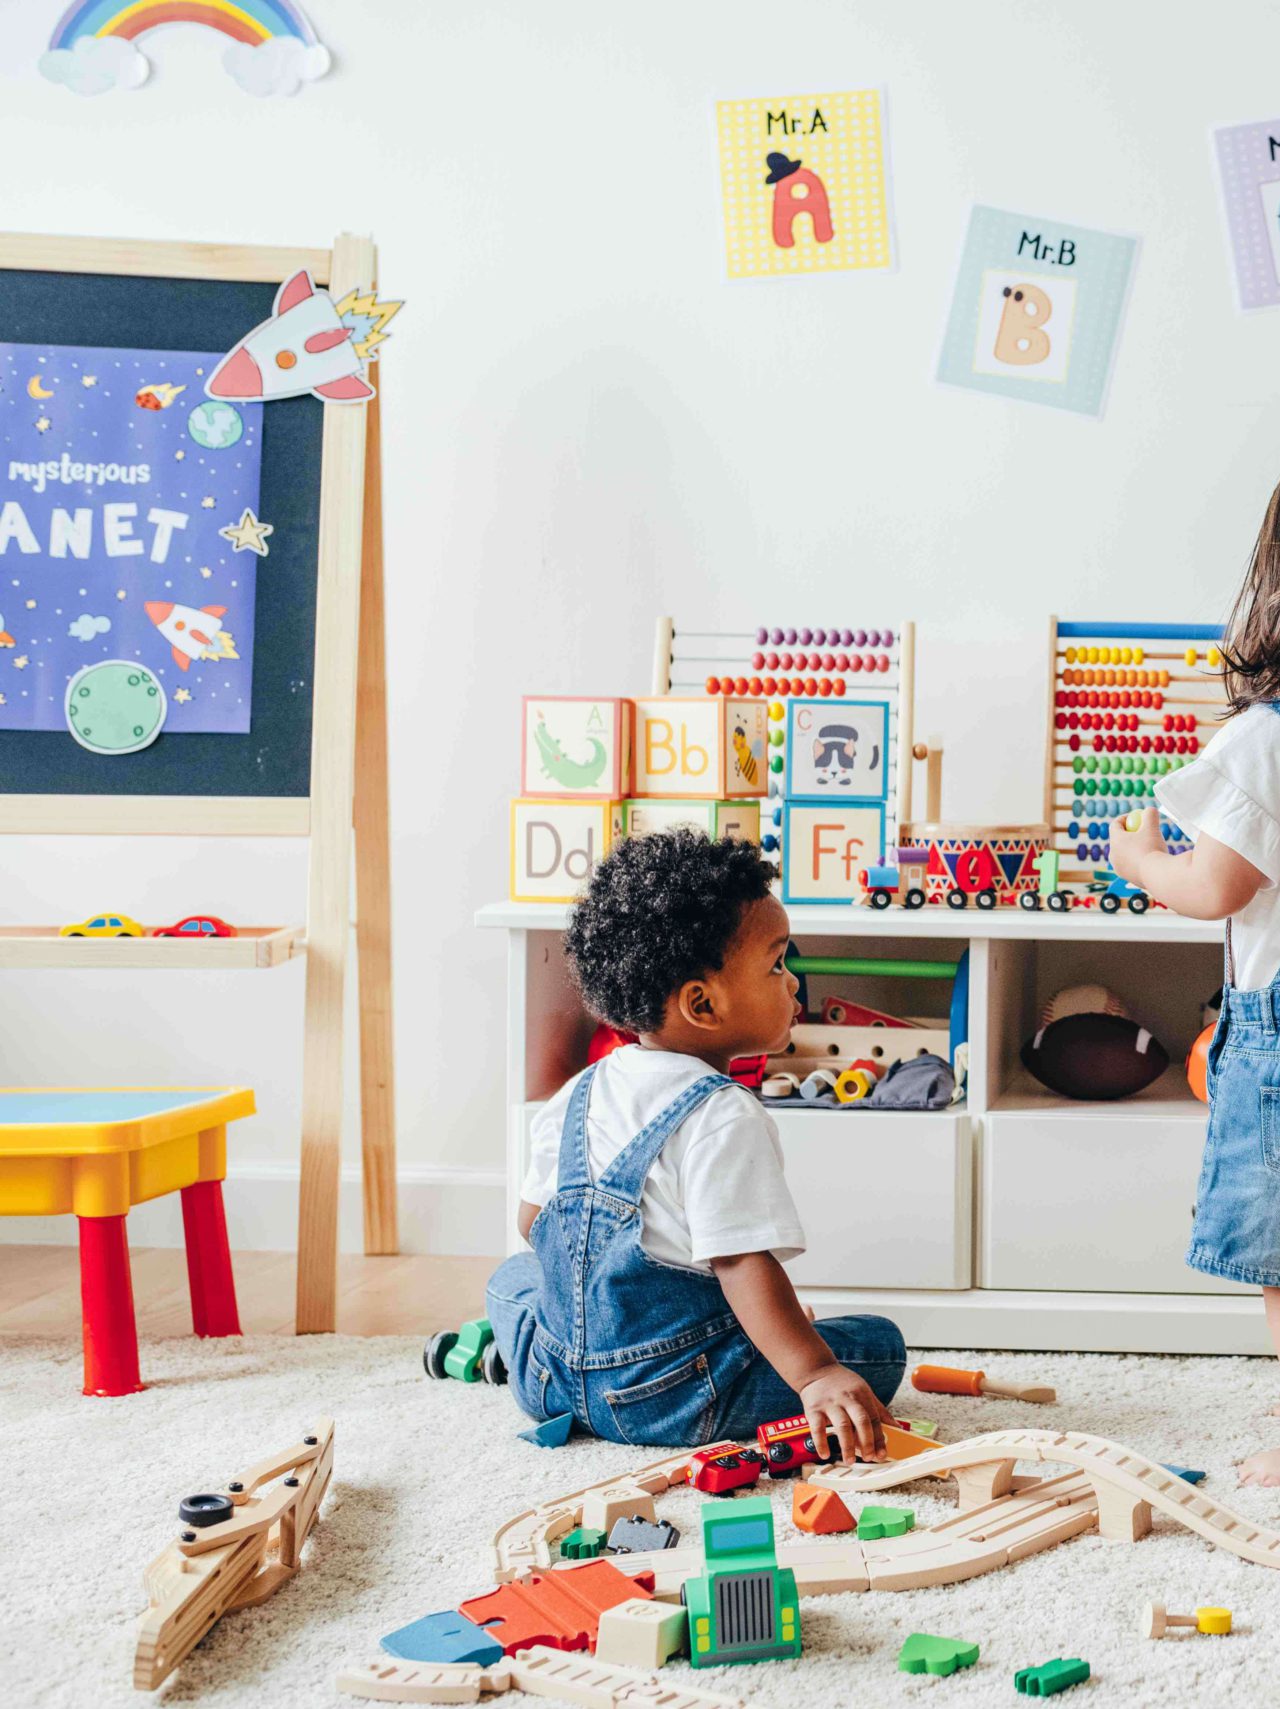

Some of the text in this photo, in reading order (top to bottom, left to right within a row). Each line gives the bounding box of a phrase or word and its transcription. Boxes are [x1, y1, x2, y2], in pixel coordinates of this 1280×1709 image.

[766, 108, 829, 136] Mr.A
[771, 167, 834, 249] A
[1016, 230, 1077, 267] Mr.B
[993, 283, 1053, 366] B
[8, 452, 152, 493] mysterious
[586, 705, 604, 727] A
[797, 709, 812, 731] C
[645, 718, 709, 776] Bb
[631, 810, 642, 833] E
[526, 821, 594, 880] Dd
[812, 824, 864, 881] Ff
